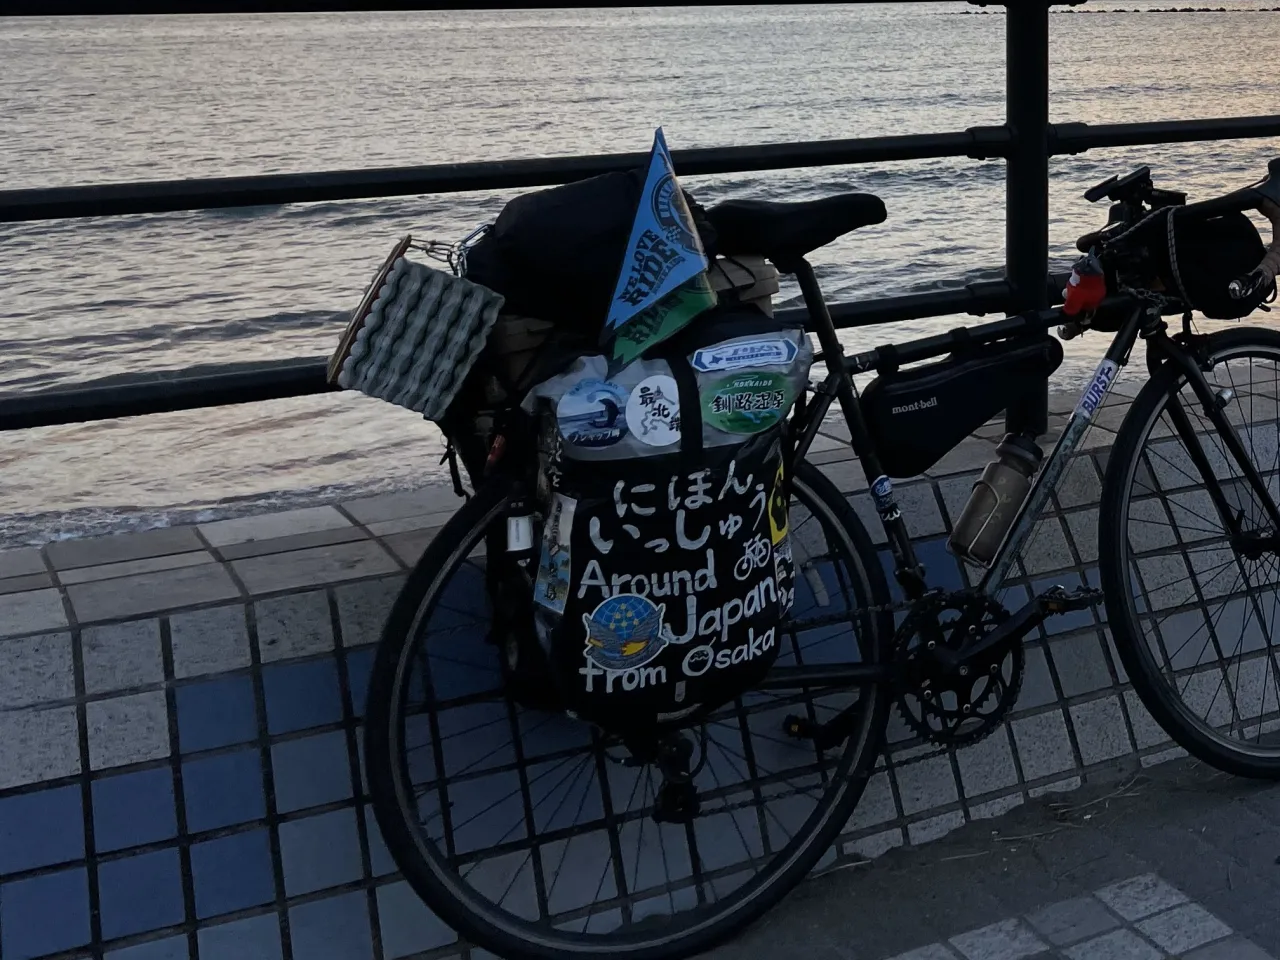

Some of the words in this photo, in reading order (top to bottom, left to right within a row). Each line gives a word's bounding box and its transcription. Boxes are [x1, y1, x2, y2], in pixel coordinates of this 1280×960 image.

[617, 275, 638, 300] WE
[632, 229, 660, 274] LOVE
[622, 239, 680, 306] RIDE
[711, 389, 786, 415] 釧路湿原
[732, 379, 773, 388] HOKKAIDO
[1082, 367, 1112, 416] BURST
[613, 459, 754, 518] にほん
[588, 483, 766, 554] いっしゅう
[577, 547, 718, 600] Around
[664, 576, 779, 645] Japan
[578, 656, 667, 693] from
[682, 625, 776, 677] Osaka
